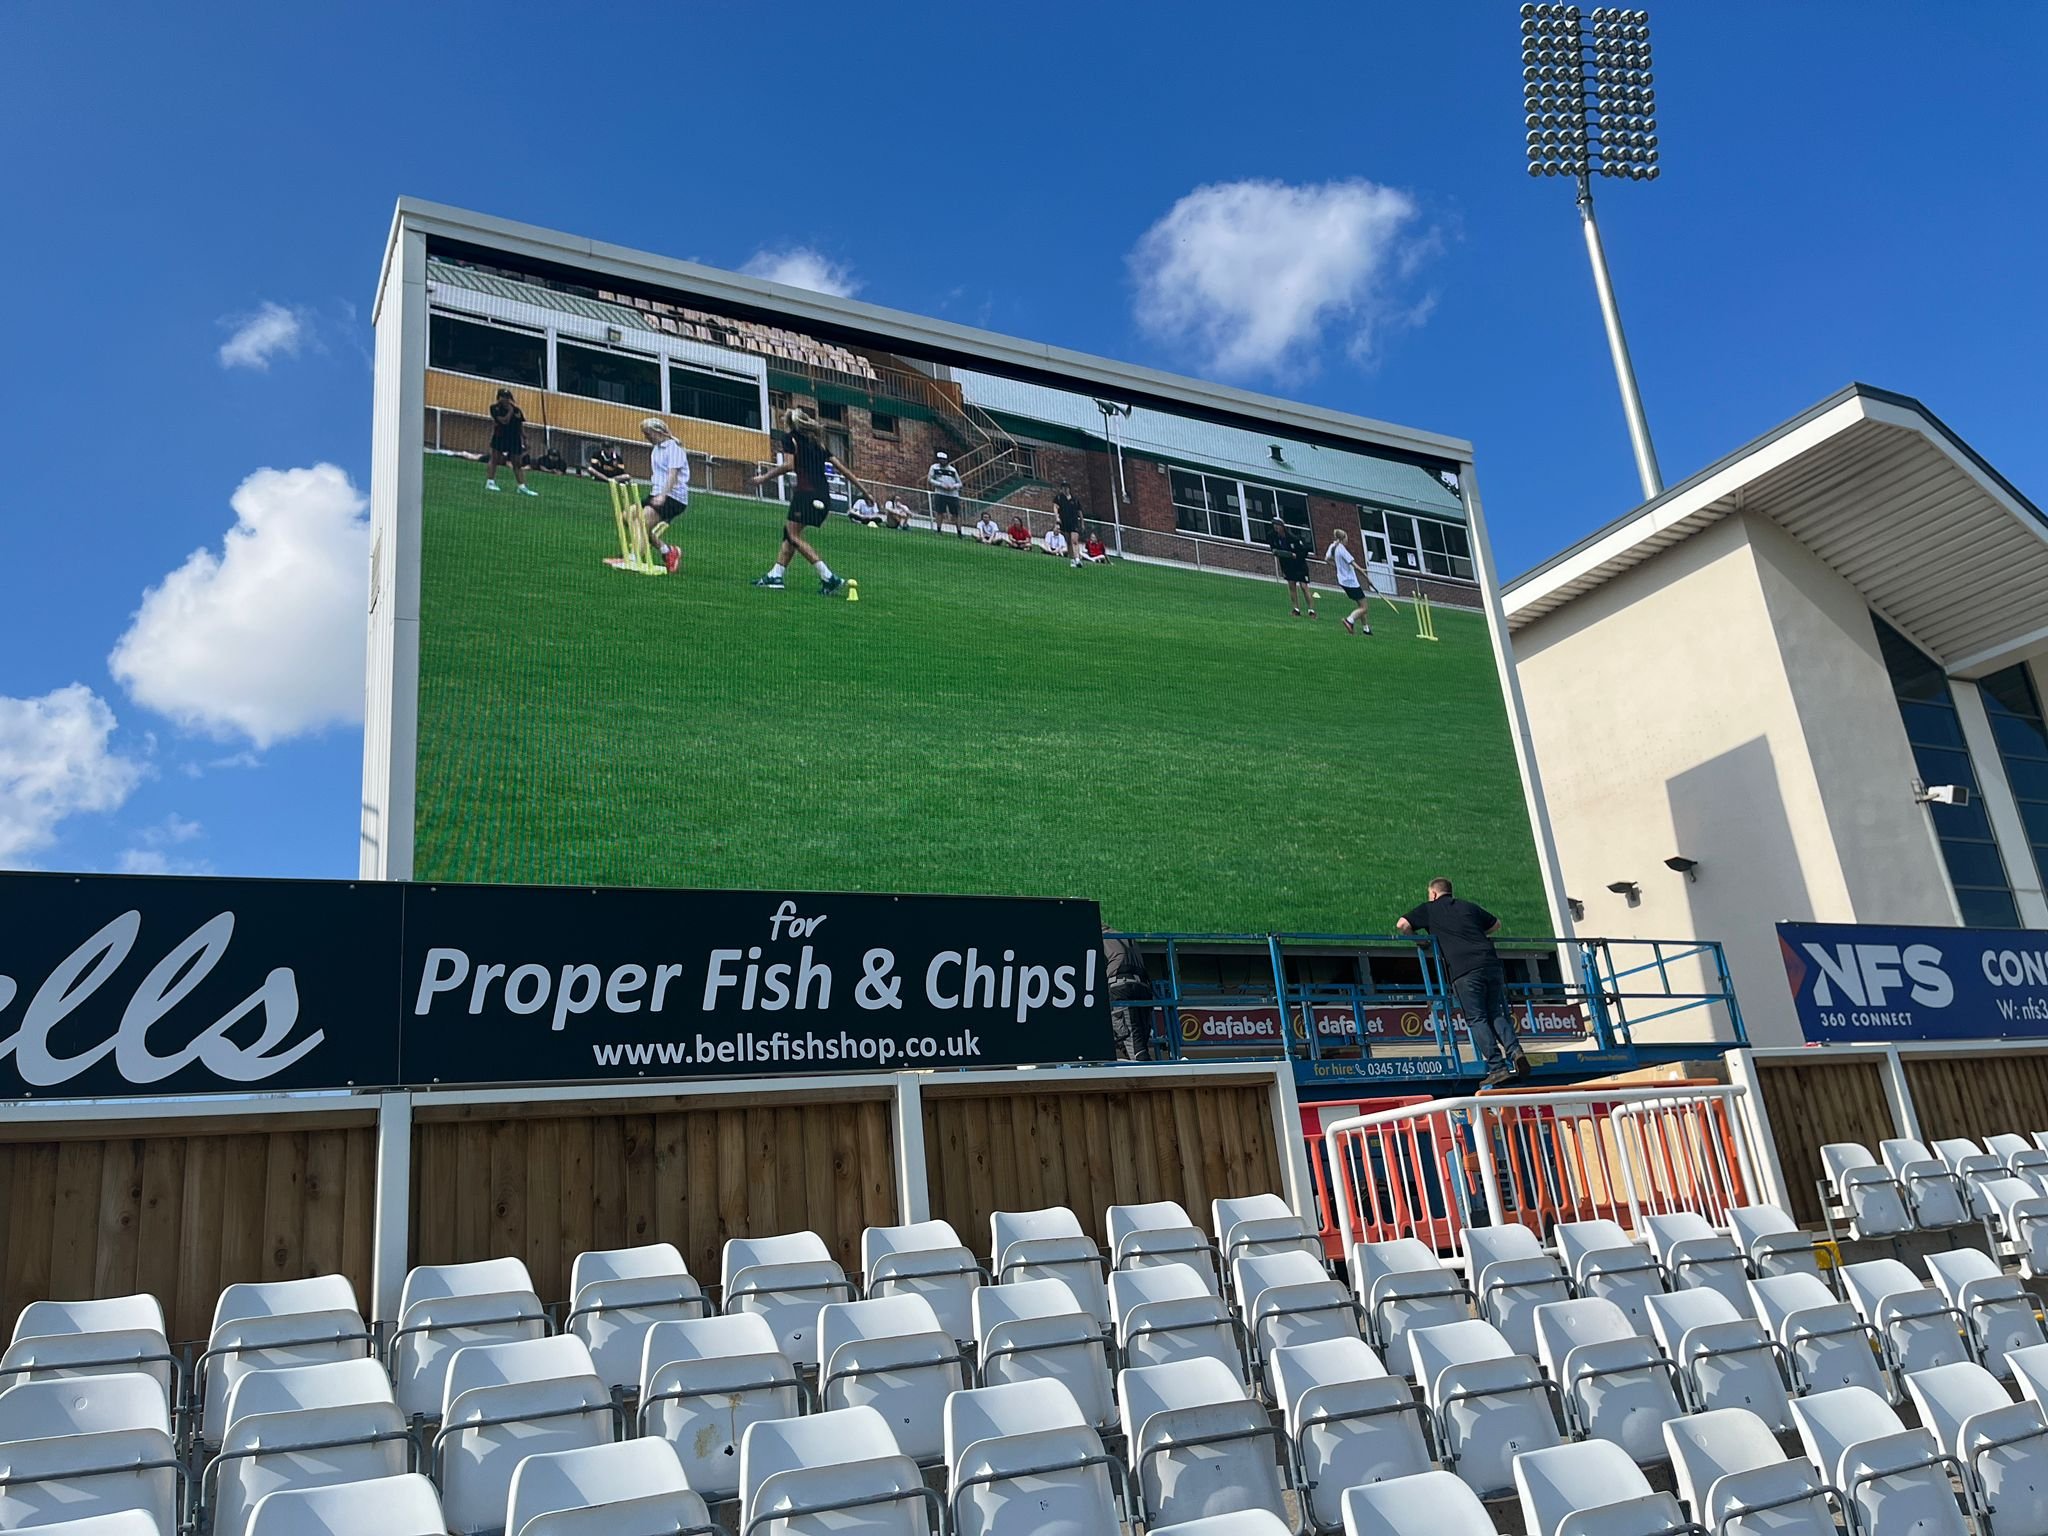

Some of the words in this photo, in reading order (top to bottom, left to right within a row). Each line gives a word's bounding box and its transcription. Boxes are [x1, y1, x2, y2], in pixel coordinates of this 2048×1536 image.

[770, 901, 827, 941] for
[1801, 942, 1954, 1008] NFS
[1981, 950, 2048, 987] CON
[415, 948, 682, 1031] Proper
[703, 945, 831, 1011] Fish
[855, 948, 902, 1010] &
[926, 948, 1097, 1024] Chips!
[1820, 1013, 1846, 1026] 360
[1851, 1012, 1912, 1026] CONNECT
[1996, 999, 2020, 1020] W:
[1202, 1015, 1274, 1039] dafabet
[1318, 1015, 1384, 1036] dafaet
[593, 1029, 980, 1066] www.bellsfishshop.co.uk
[1314, 1064, 1329, 1076] for
[1367, 1063, 1394, 1076] 0345
[1395, 1062, 1415, 1075] 745
[1417, 1061, 1442, 1074] 0000
